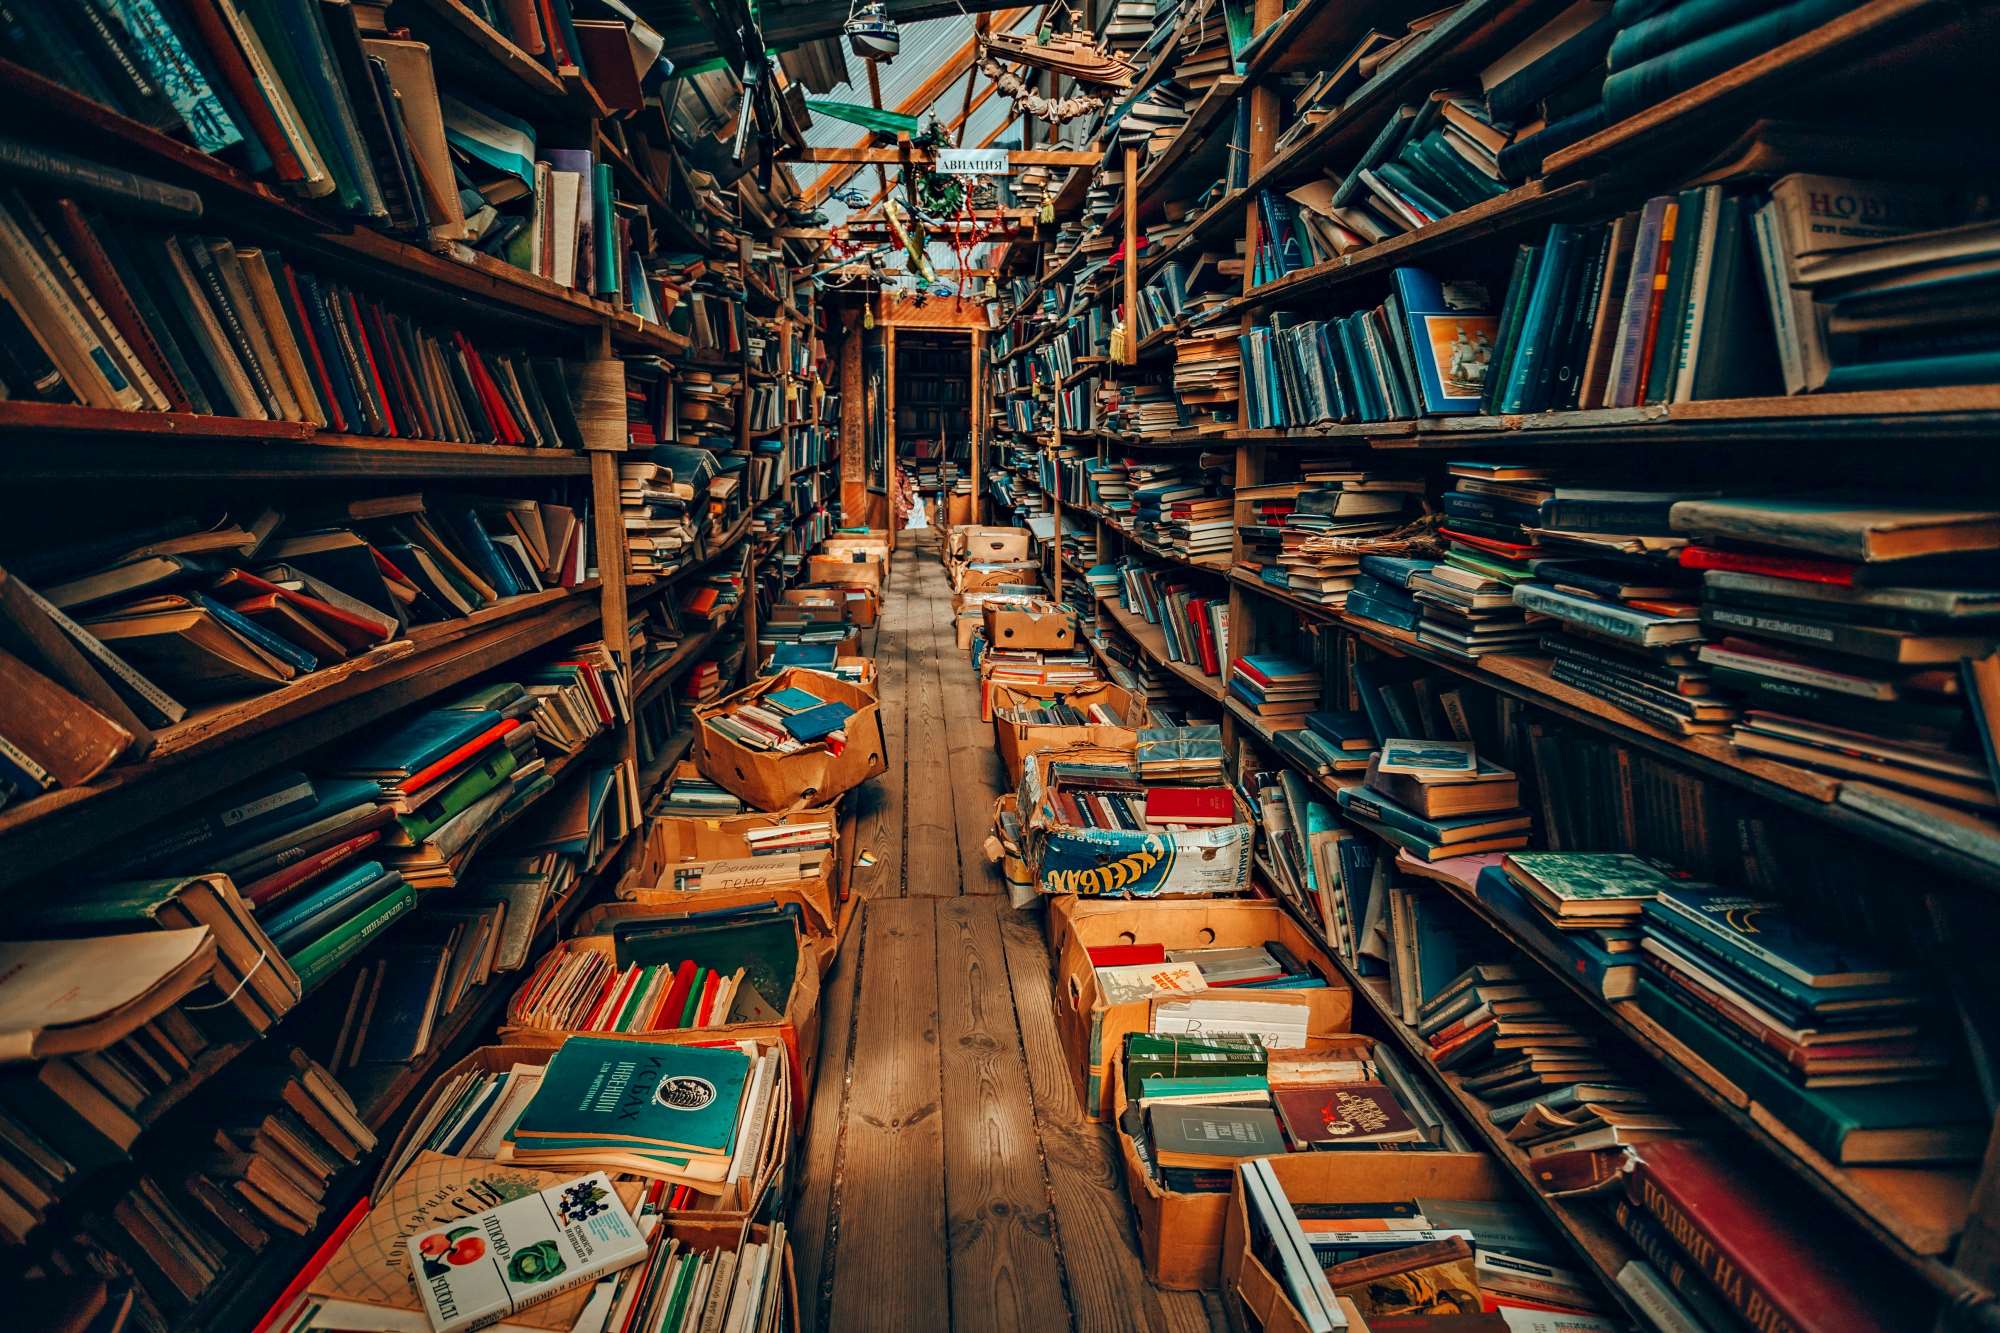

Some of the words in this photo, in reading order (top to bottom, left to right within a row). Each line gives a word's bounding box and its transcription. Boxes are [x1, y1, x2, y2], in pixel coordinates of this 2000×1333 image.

[943, 160, 1003, 171] АВИАЦИЯ
[360, 900, 406, 938] СПРАВОЧНИК
[594, 1061, 637, 1112] ИНВЕНЦИИ
[481, 1213, 510, 1257] ОВОЩИ
[1644, 1179, 1714, 1267] ПОДВИГ
[1713, 1256, 1745, 1307] НА
[430, 1275, 459, 1321] ПЛОДЫ
